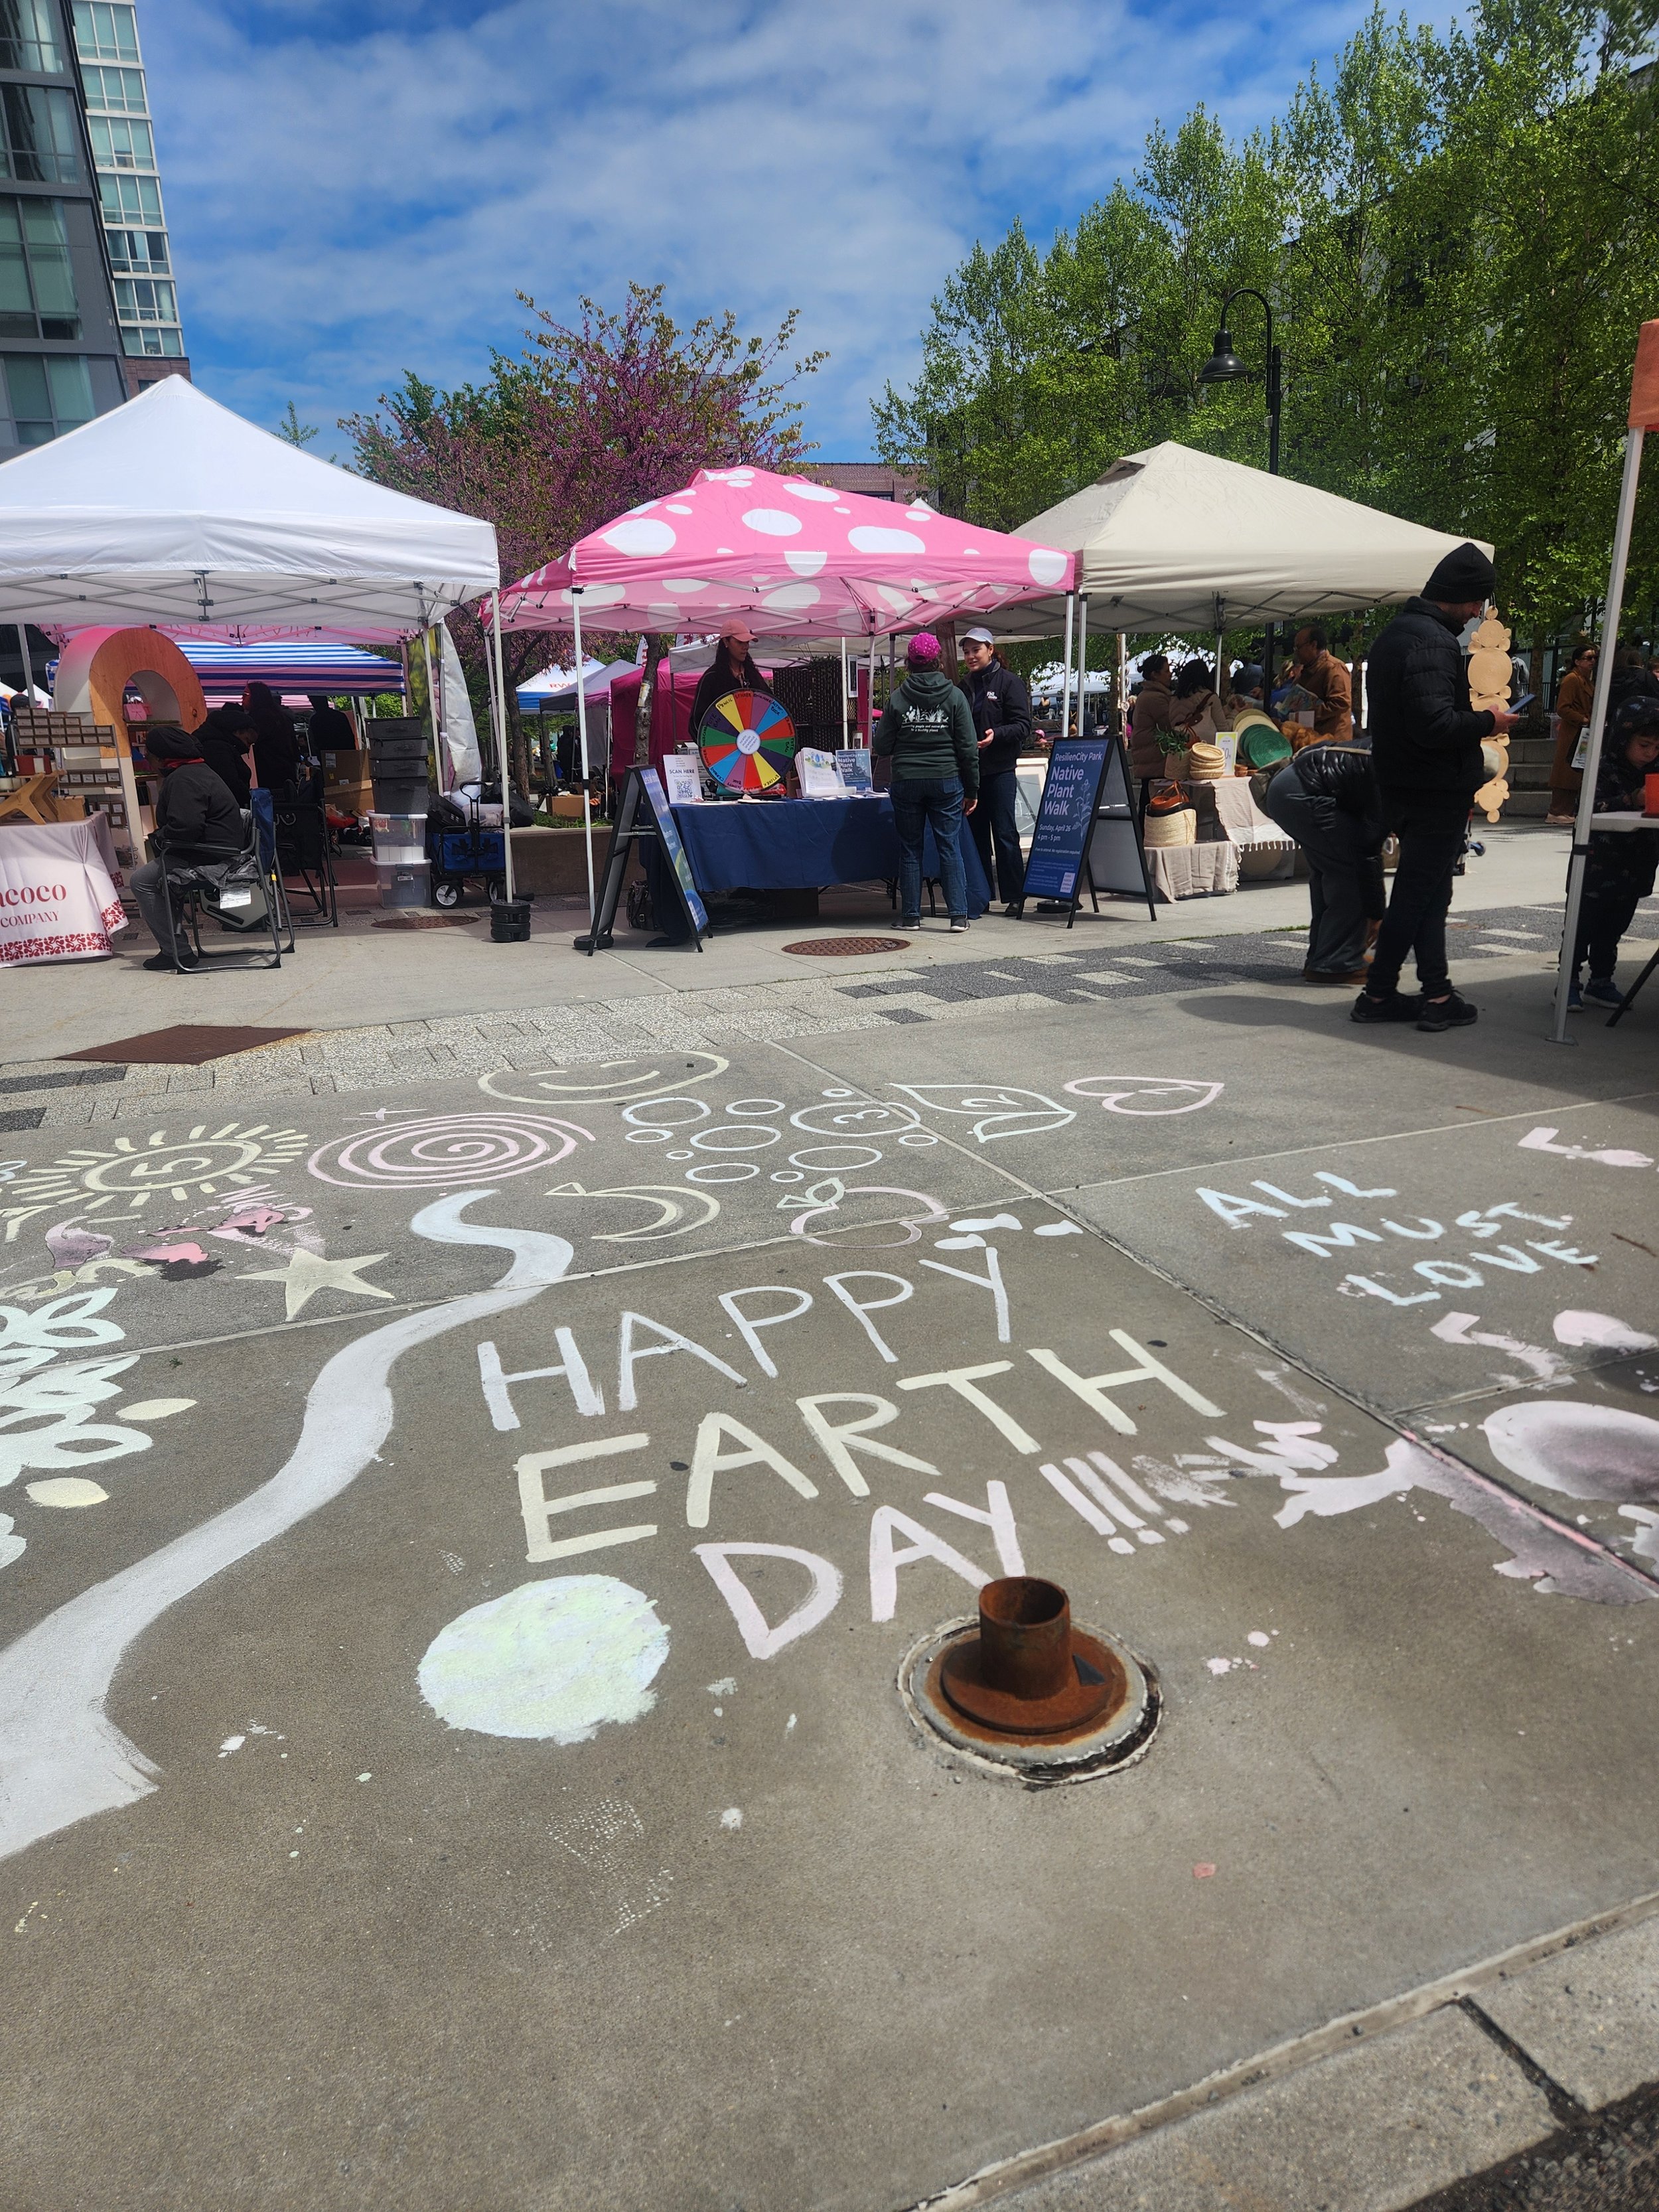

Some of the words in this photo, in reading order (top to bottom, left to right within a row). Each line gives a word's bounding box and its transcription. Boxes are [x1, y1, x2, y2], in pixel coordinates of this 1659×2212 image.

[717, 698, 733, 709] PENCIL
[1054, 751, 1088, 763] ResilienCity
[1088, 751, 1102, 761] Park
[763, 774, 780, 787] STICKER
[1050, 764, 1084, 781] Native
[1047, 783, 1074, 798] Plant
[1044, 800, 1070, 816] Walk
[1039, 824, 1056, 832] Sunday,
[1055, 824, 1066, 833] April
[1, 911, 59, 928] COMPANY
[1195, 1171, 1398, 1230] ALL
[1281, 1201, 1571, 1258] MUST
[1344, 1239, 1599, 1306] LOVE
[476, 1246, 1011, 1430] HAPPY
[514, 1329, 1228, 1564] EARTH
